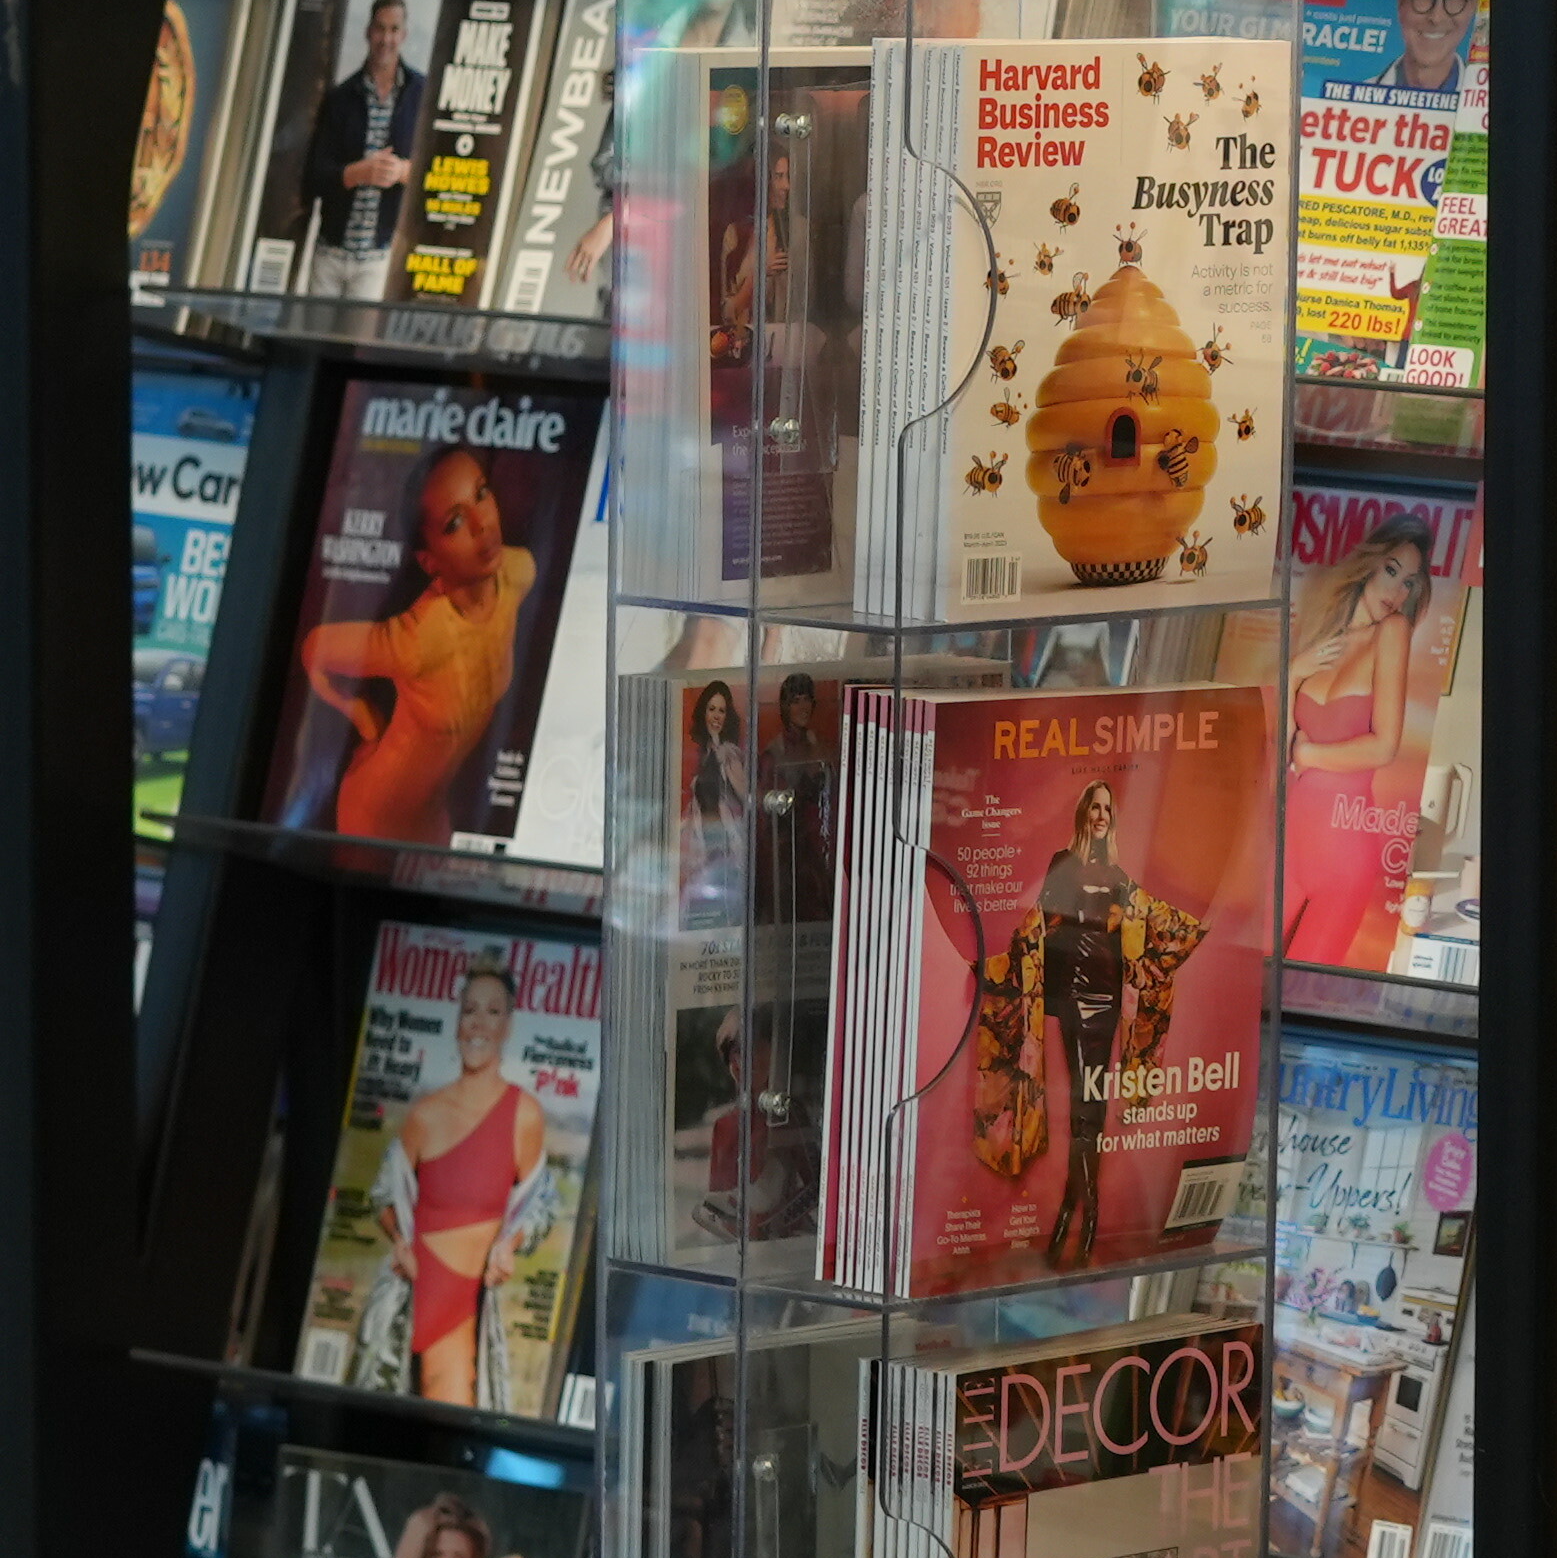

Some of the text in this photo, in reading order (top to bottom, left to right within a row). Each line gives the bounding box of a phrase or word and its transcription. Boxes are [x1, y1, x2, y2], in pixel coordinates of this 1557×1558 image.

[978, 58, 1101, 94] Harvard
[978, 97, 1109, 130] Business
[976, 135, 1084, 169] Review
[1216, 137, 1276, 170] The
[1131, 173, 1273, 215] Busyness
[1200, 213, 1273, 254] Trap
[1191, 263, 1274, 279] Activity is not
[1327, 311, 1362, 331] 220
[1083, 1055, 1240, 1099] Kristen Bell
